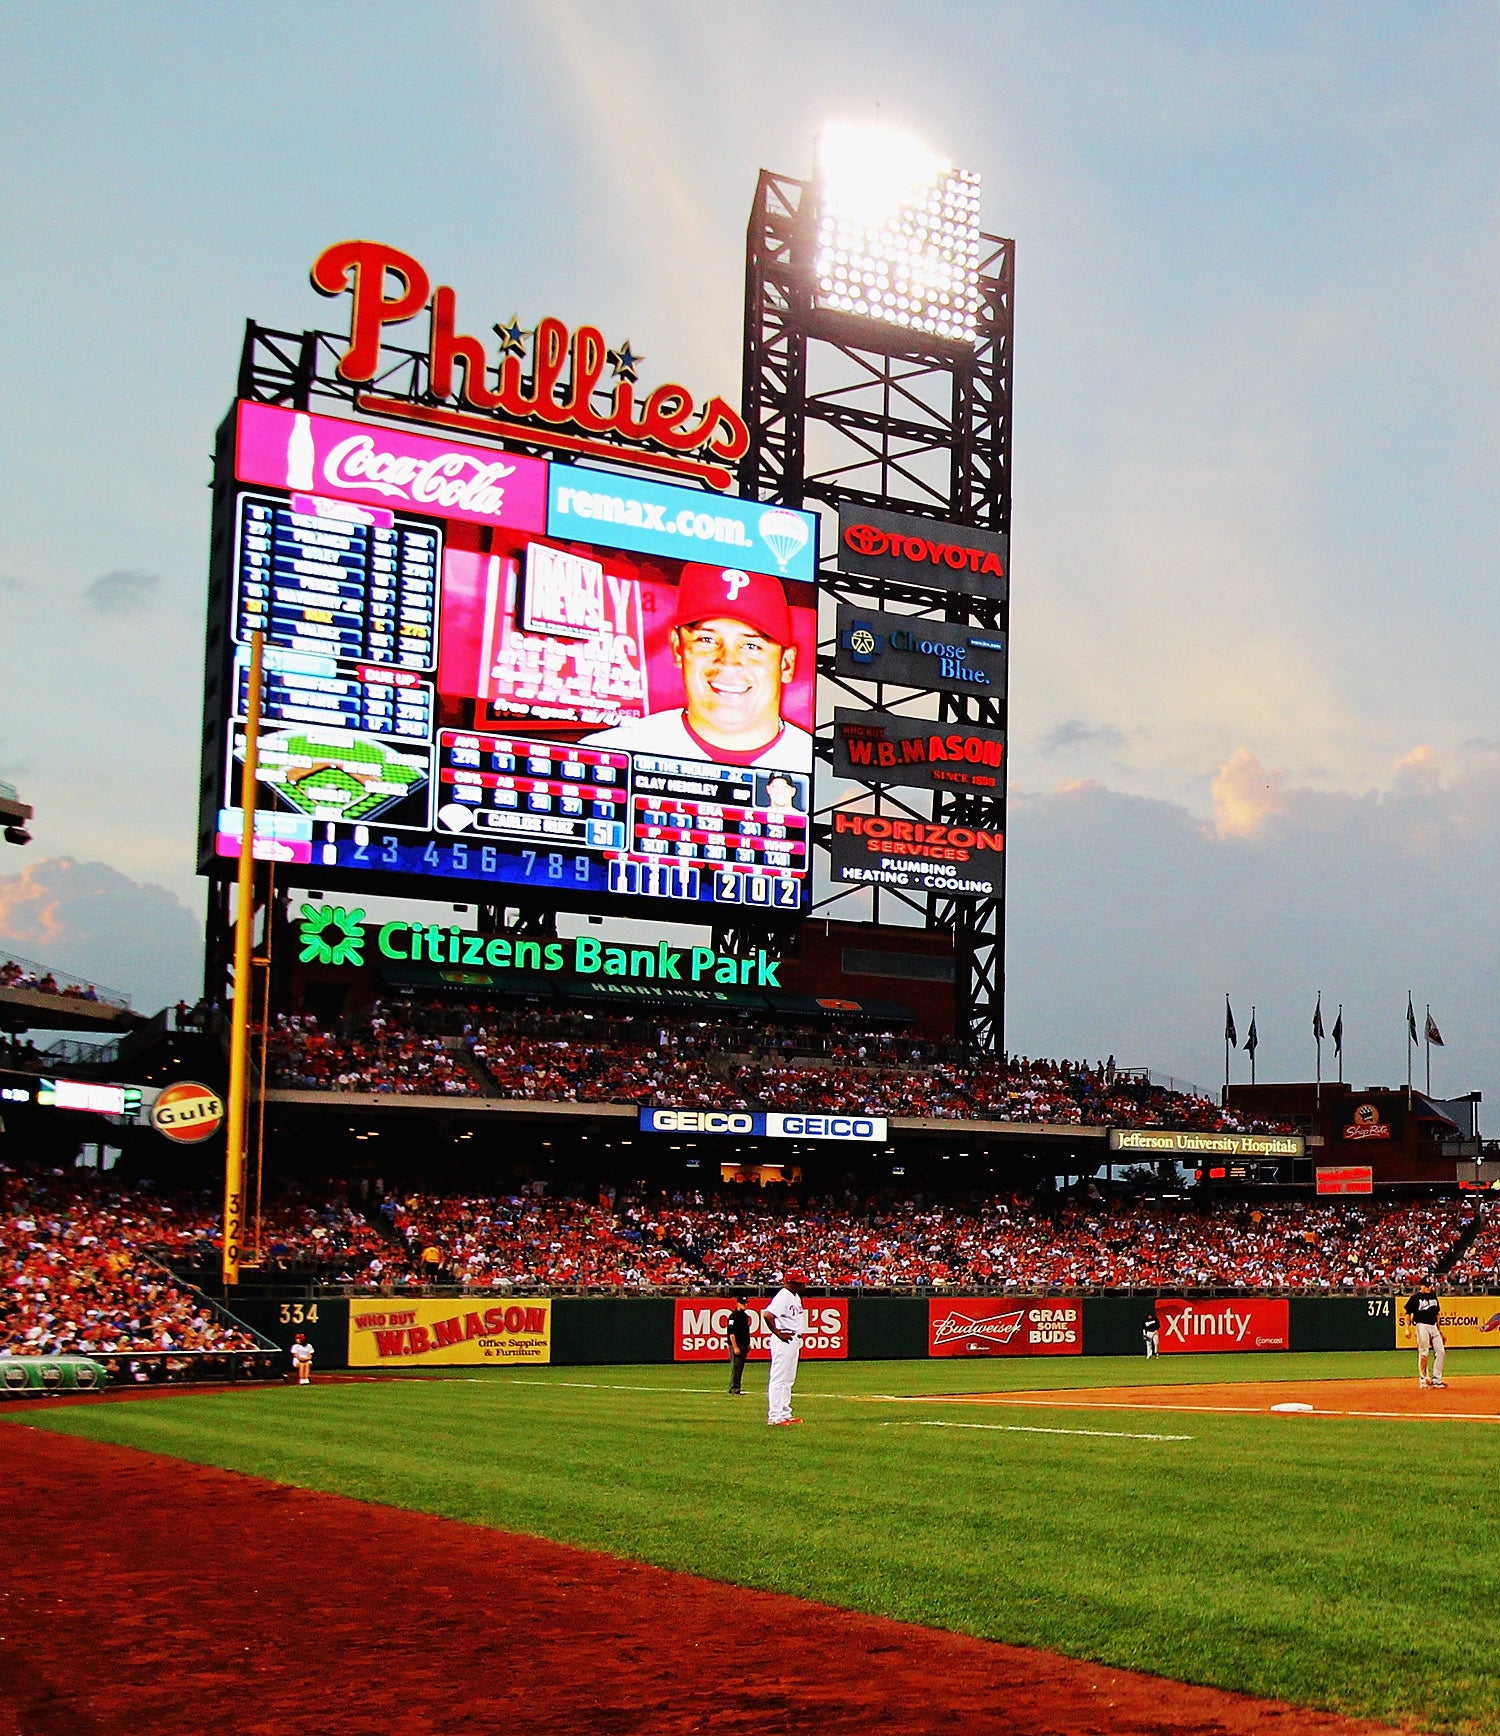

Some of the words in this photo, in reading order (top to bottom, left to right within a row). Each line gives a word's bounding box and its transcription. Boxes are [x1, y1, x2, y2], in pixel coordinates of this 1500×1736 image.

[311, 239, 751, 463] Phillies
[886, 532, 1004, 577] TOYOTA
[721, 569, 750, 600] P
[890, 630, 967, 660] Choose
[365, 669, 394, 684] DUE
[395, 673, 417, 686] UP
[941, 657, 991, 685] Blue.
[568, 751, 579, 762] H
[600, 754, 611, 765] R
[658, 760, 679, 774] THE
[635, 775, 667, 791] CLAY
[667, 778, 719, 797] HENSLEY
[933, 769, 969, 784] SINCE
[648, 798, 662, 810] W
[676, 802, 686, 813] L
[697, 804, 724, 818] ERA
[744, 810, 754, 821] K
[488, 813, 542, 832] CARLOS
[543, 820, 575, 835] RUIZ
[593, 822, 614, 846] 51
[835, 813, 1004, 852] HORIZON
[680, 830, 691, 842] R
[707, 833, 726, 846] ER
[741, 837, 751, 848] H
[763, 839, 795, 853] WHIP
[866, 839, 971, 863] SERVICES
[382, 836, 398, 863] 3
[423, 841, 440, 868] 4
[453, 843, 468, 870] 5
[481, 847, 497, 873] 6
[521, 850, 537, 877] 7
[549, 853, 563, 879] 8
[575, 855, 590, 882] 9
[880, 857, 958, 877] PLUMBING
[721, 874, 736, 899] 2
[751, 877, 766, 902] 0
[780, 880, 795, 905] 2
[841, 867, 910, 885] HEATING
[923, 876, 994, 894] COOLING
[378, 920, 564, 973] Citizens
[574, 936, 683, 982] Bank
[690, 945, 783, 989] Park
[591, 982, 663, 997] HARRY
[155, 1100, 220, 1126] Gulf
[652, 1109, 753, 1132] GEICO
[782, 1116, 875, 1138] GEICO
[1118, 1132, 1174, 1150] Jefferson
[1177, 1135, 1239, 1155] University
[1242, 1137, 1298, 1157] Hospitals
[279, 1303, 320, 1325] 334
[354, 1313, 386, 1329] WHO
[388, 1311, 416, 1326] BUT
[1028, 1309, 1077, 1323] GRAB
[1367, 1300, 1390, 1317] 374
[932, 1319, 1022, 1337] Budweiser
[1037, 1322, 1068, 1331] SOME
[1165, 1306, 1252, 1343] xfinity
[478, 1339, 507, 1349] Office
[508, 1338, 548, 1352] Supplies
[1029, 1330, 1076, 1344] BUDS
[484, 1348, 493, 1357] &
[496, 1348, 541, 1357] Furniture
